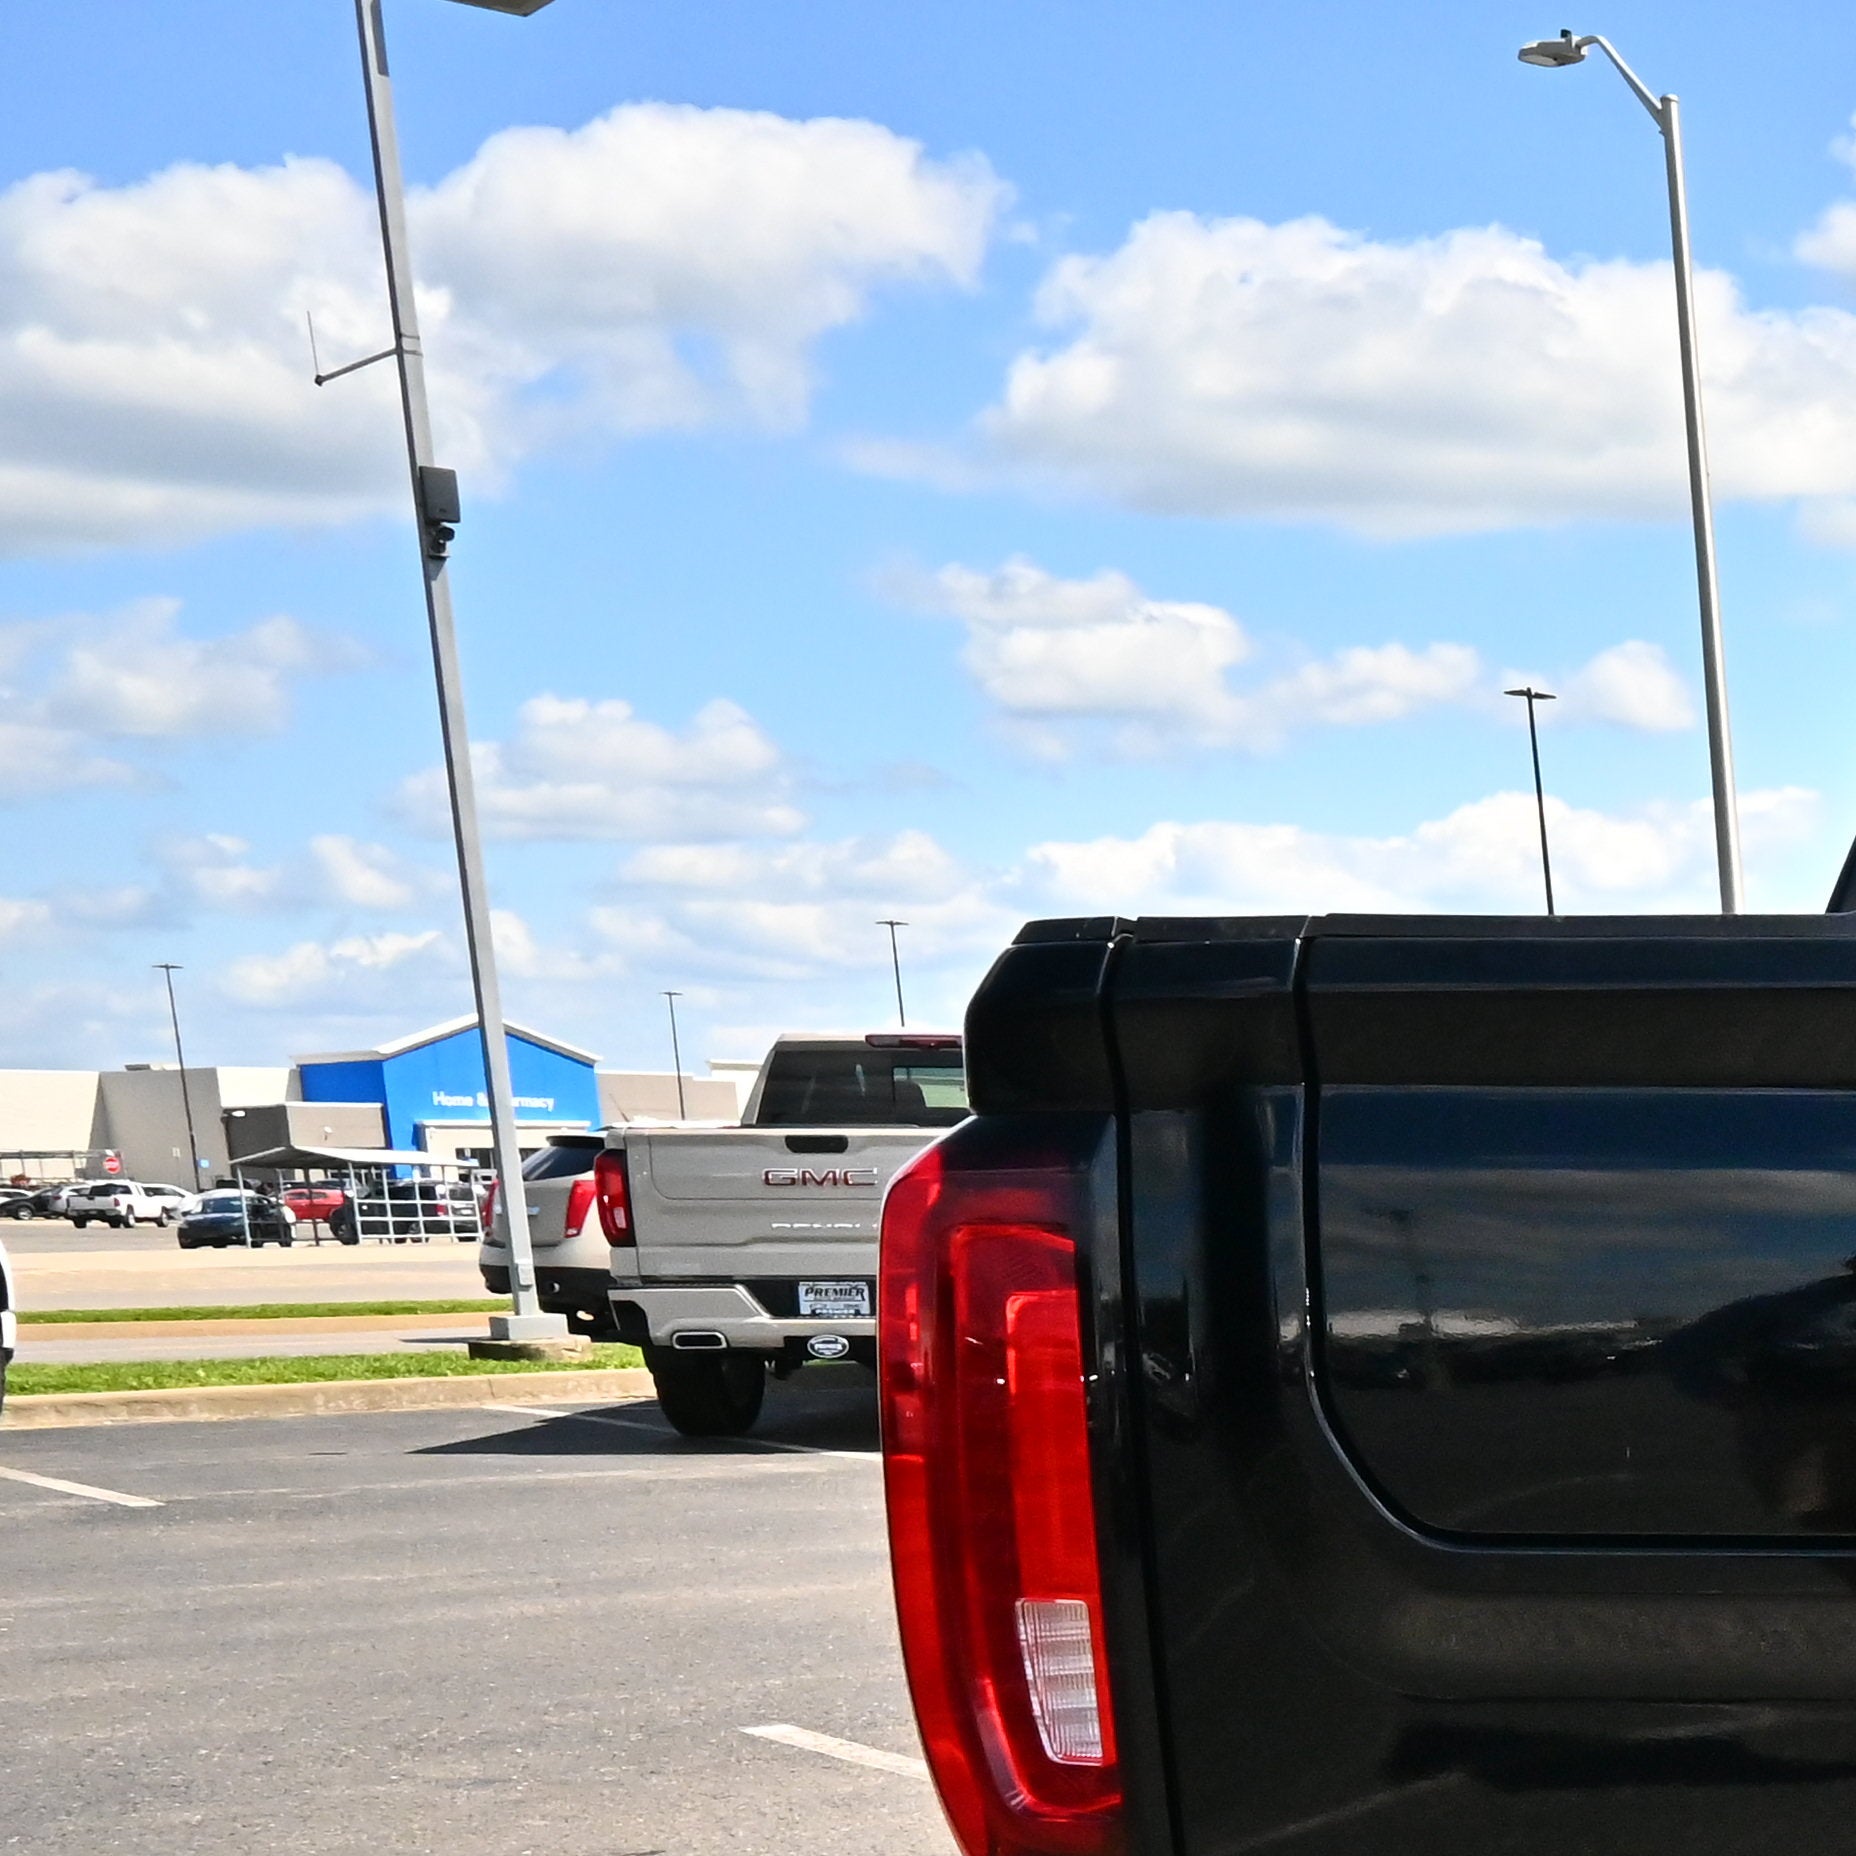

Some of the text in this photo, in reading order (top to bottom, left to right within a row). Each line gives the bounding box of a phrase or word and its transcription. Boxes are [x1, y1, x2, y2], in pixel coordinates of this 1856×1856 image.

[432, 1091, 474, 1107] Home
[762, 1167, 878, 1187] GMC
[804, 1286, 866, 1302] PREMIER
